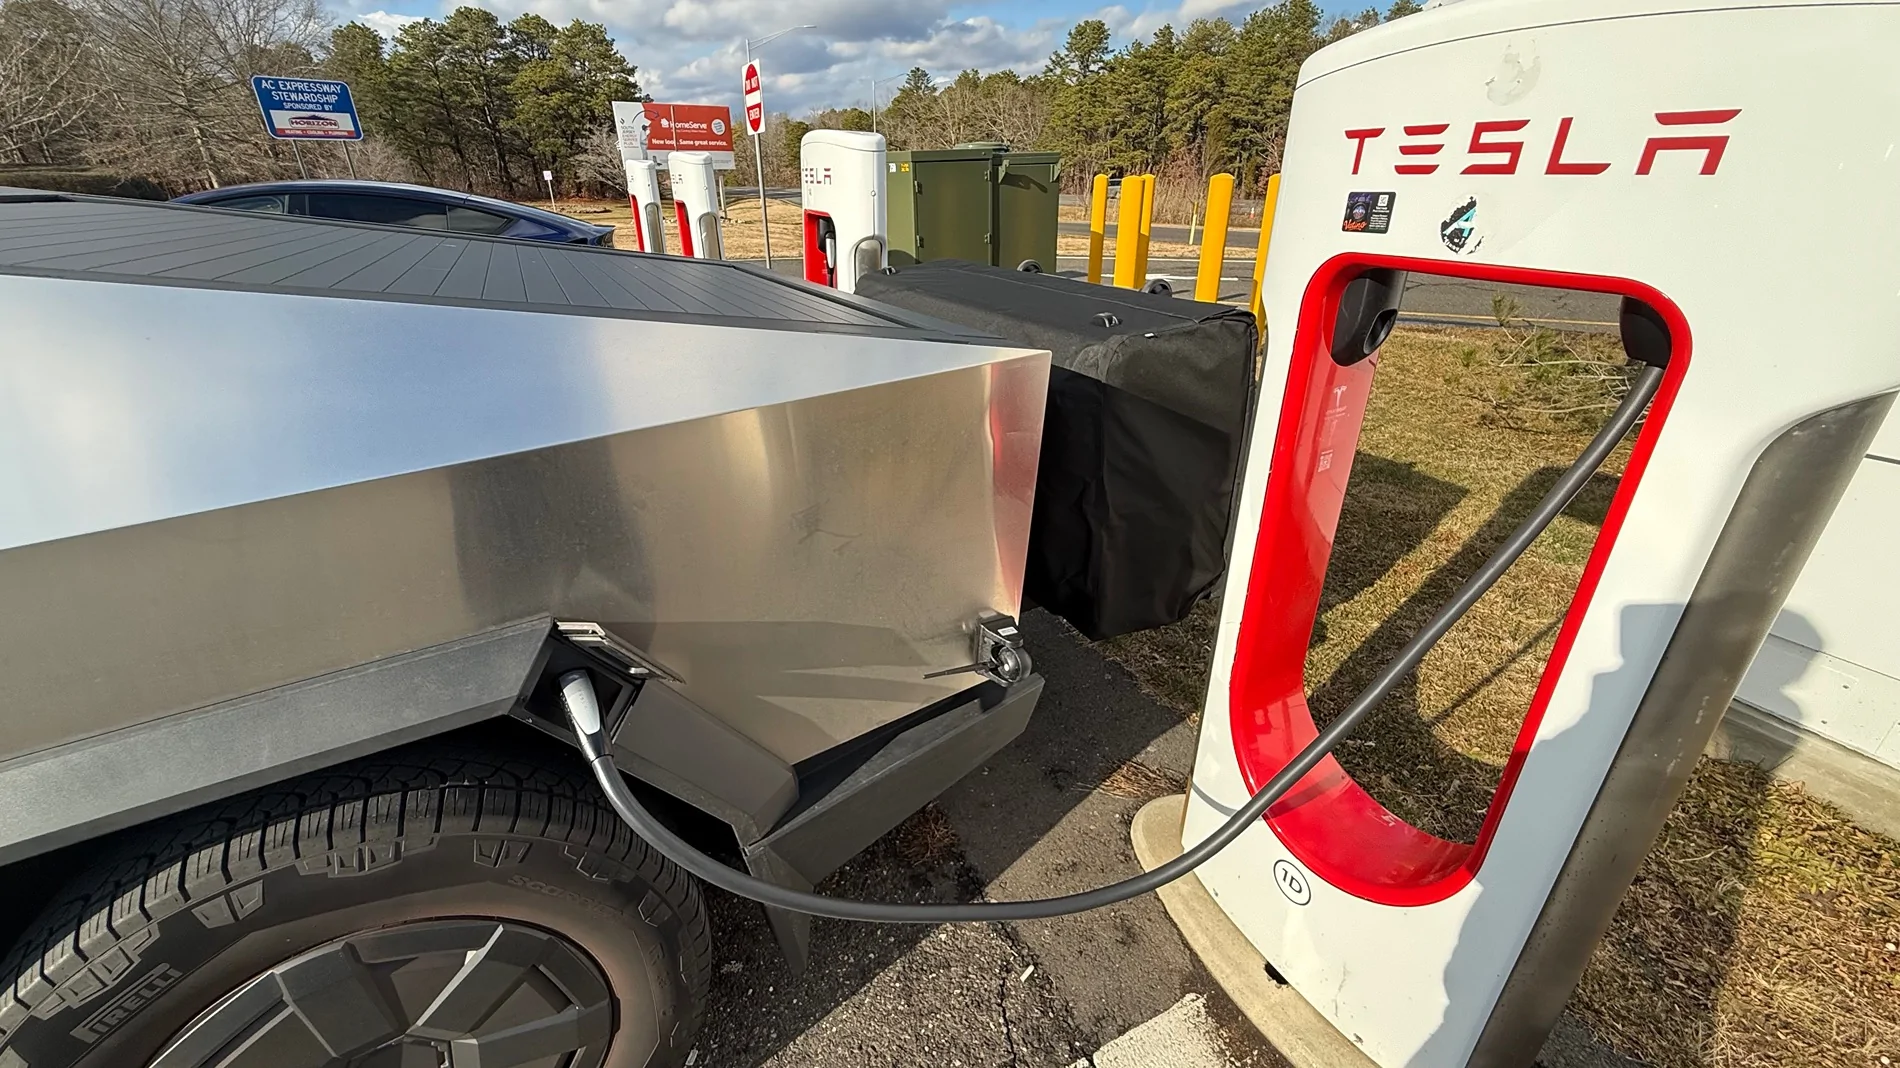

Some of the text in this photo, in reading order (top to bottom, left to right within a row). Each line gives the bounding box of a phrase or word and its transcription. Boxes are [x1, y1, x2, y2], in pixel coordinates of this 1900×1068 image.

[261, 80, 341, 93] AC EXPRESSWAY
[271, 91, 338, 103] STEWARDSHIP
[283, 102, 322, 110] SPONSORED
[669, 121, 707, 129] HomeServe
[1344, 109, 1742, 175] TESLA
[1282, 867, 1302, 894] 1D
[70, 963, 184, 1044] PIRELLI
